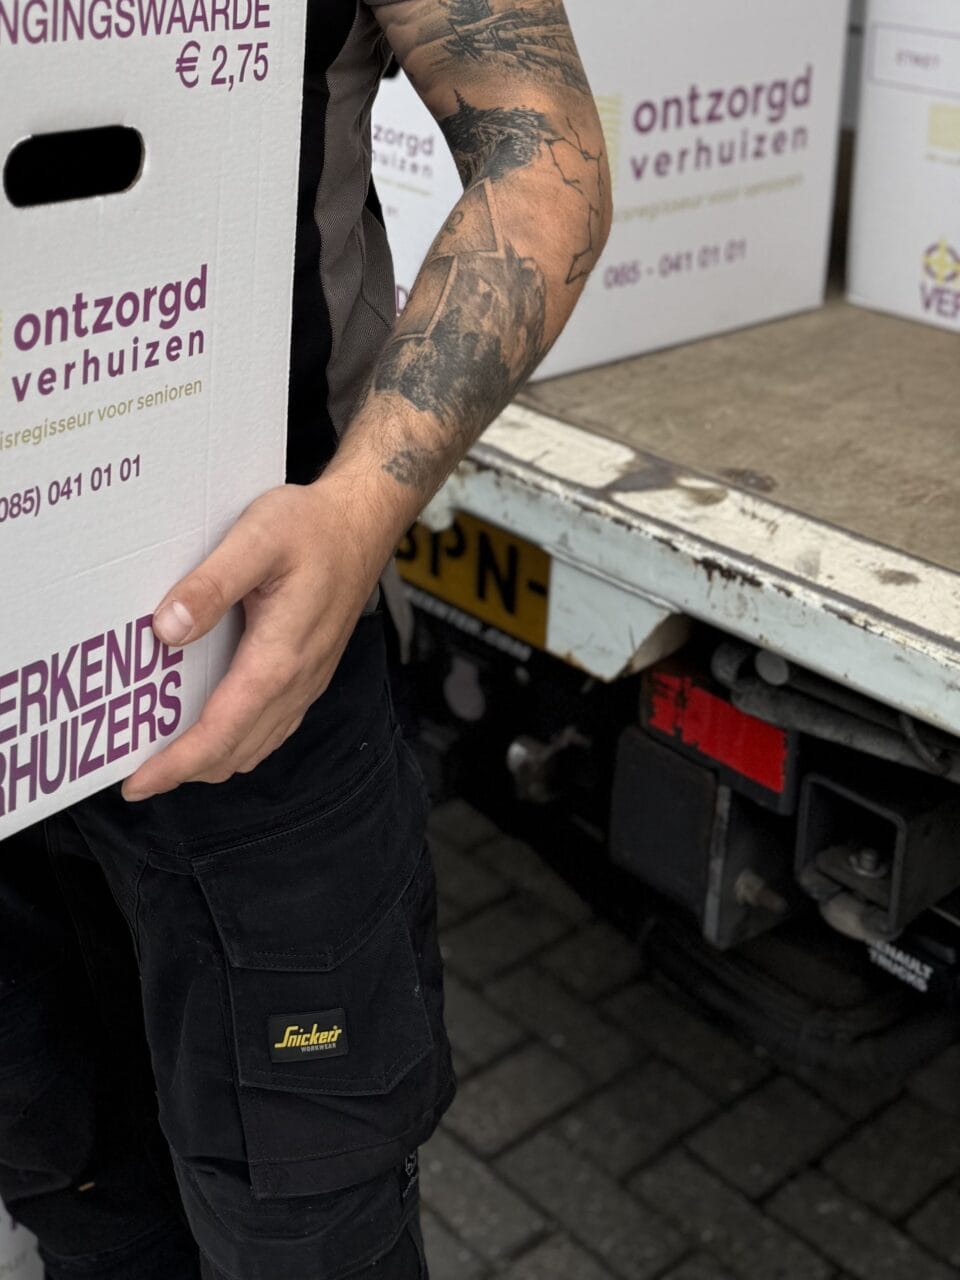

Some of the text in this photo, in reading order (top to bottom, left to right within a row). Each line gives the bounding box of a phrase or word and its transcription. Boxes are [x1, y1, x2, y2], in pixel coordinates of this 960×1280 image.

[175, 40, 269, 92] € 2,75
[633, 64, 813, 135] ontzorgd
[373, 124, 434, 157] zorgd
[630, 126, 808, 181] verhuizen
[13, 263, 208, 351] ontzorgd
[11, 328, 205, 403] verhuizen
[97, 398, 134, 422] voor
[137, 378, 202, 411] senioren
[47, 473, 82, 506] 041
[91, 463, 112, 491] 01
[120, 454, 140, 482] 01
[274, 1023, 342, 1049] Snickers
[300, 1042, 337, 1054] WORKWEAR
